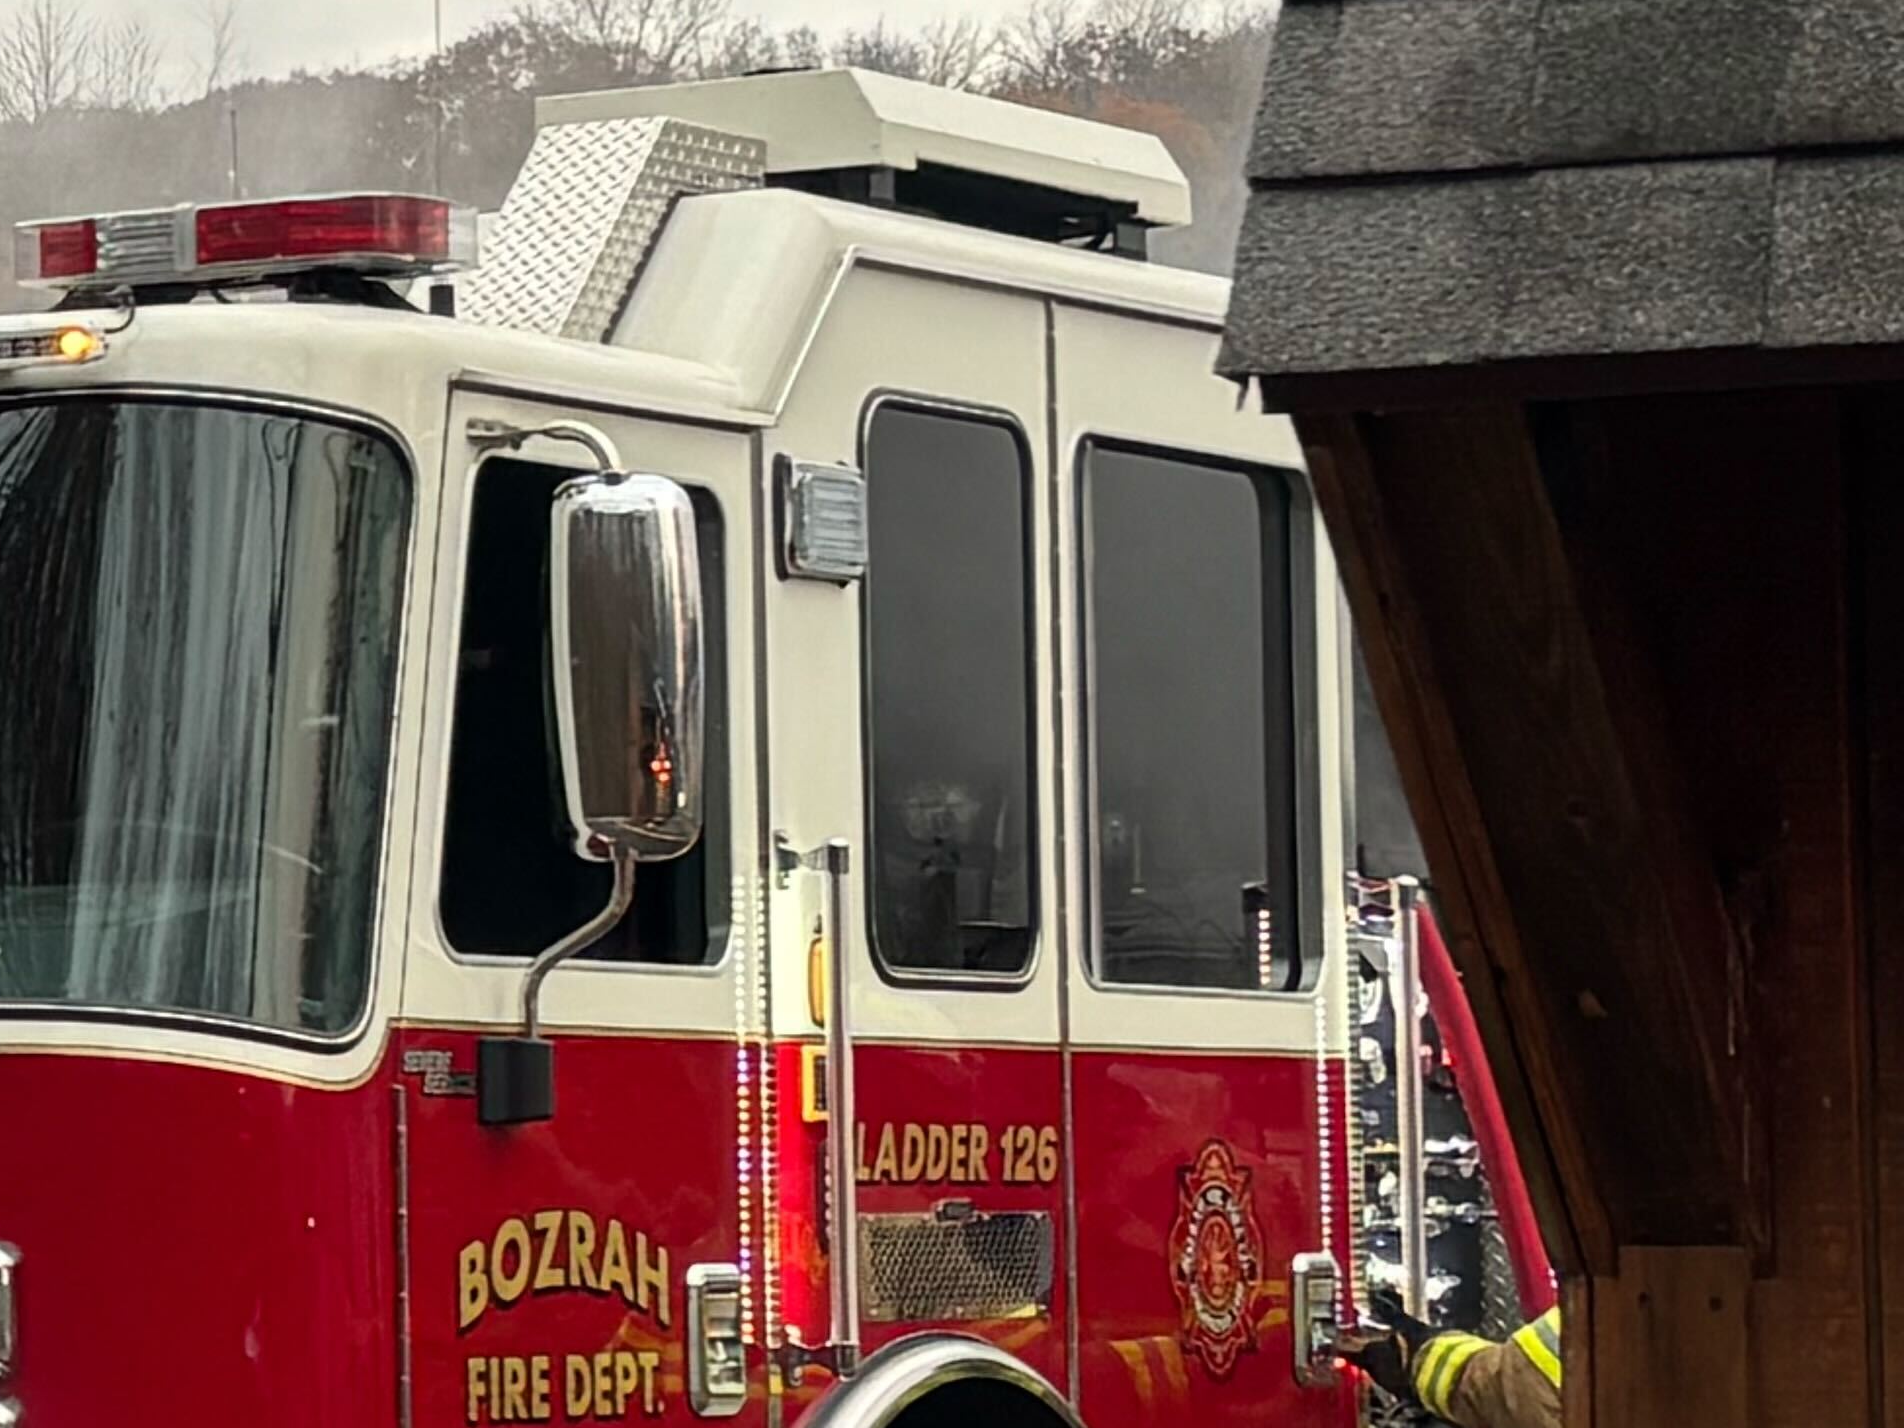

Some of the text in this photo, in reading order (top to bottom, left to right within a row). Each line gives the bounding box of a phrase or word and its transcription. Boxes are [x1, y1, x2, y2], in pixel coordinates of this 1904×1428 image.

[855, 1122, 1058, 1182] LADDER 126
[459, 1210, 671, 1328] BOZRAH
[467, 1352, 665, 1422] FIRE DEPT.
